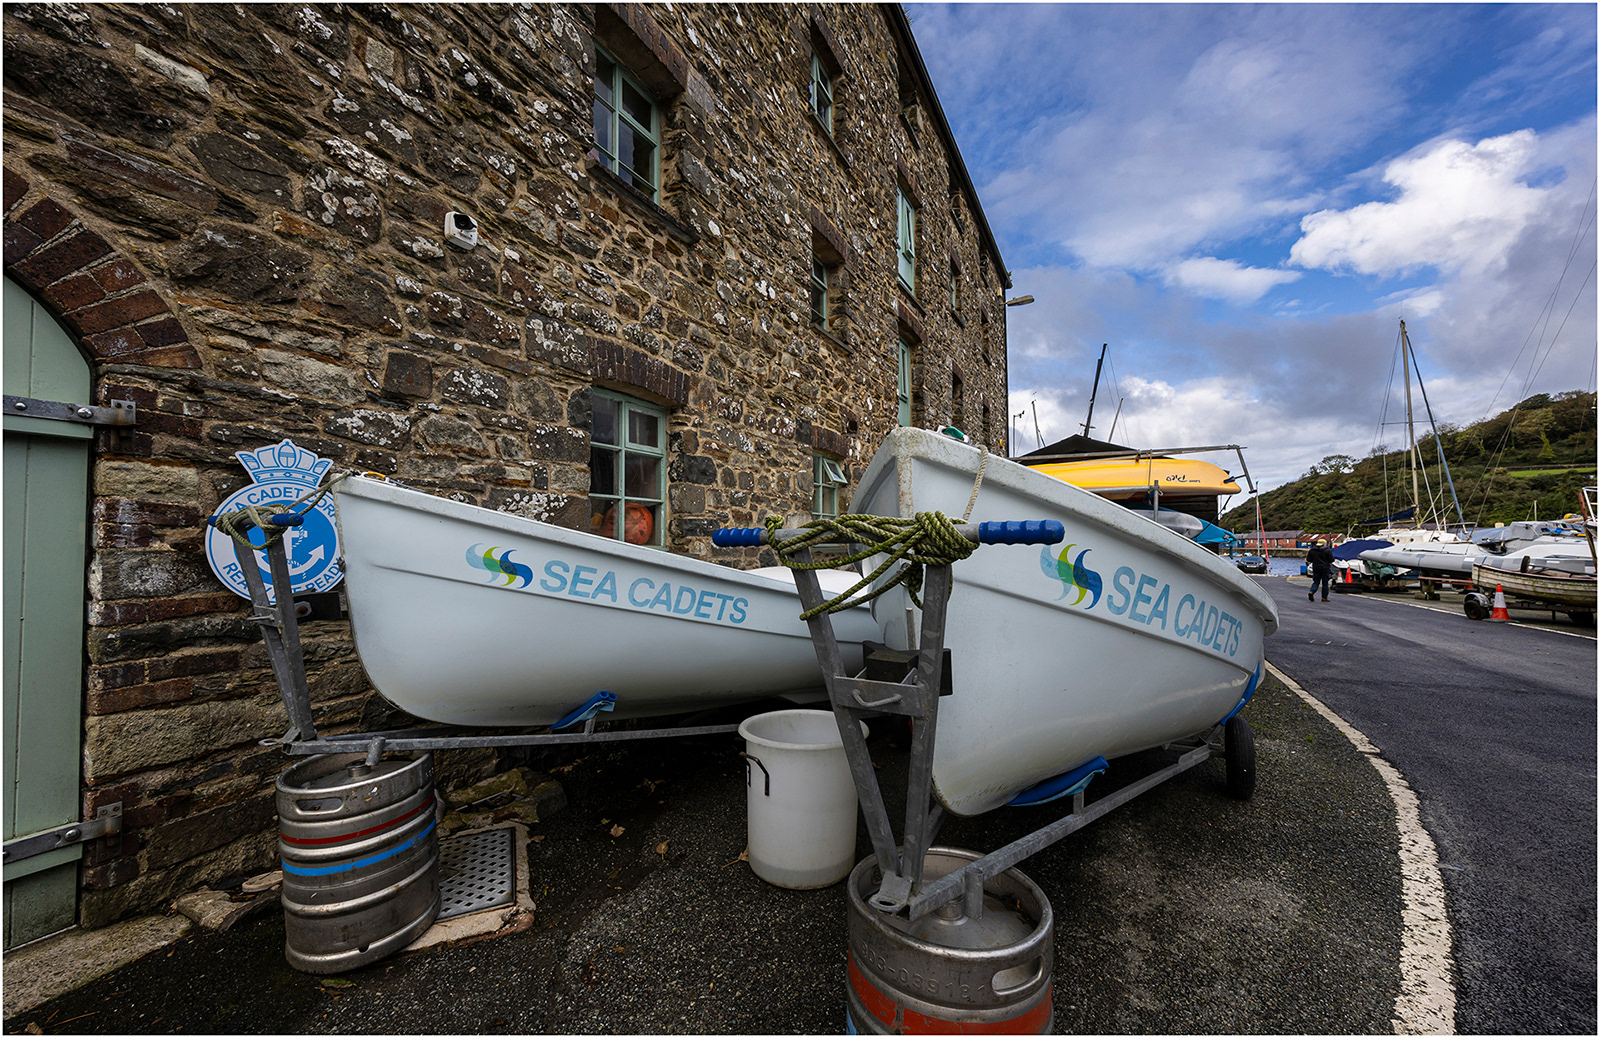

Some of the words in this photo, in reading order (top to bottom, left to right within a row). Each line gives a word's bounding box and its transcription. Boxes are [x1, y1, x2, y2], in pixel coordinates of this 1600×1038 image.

[247, 486, 303, 505] CADET
[539, 560, 617, 602] SEA
[628, 577, 749, 624] CADETS
[1106, 566, 1170, 631] SEA
[1174, 593, 1243, 657] CADETS
